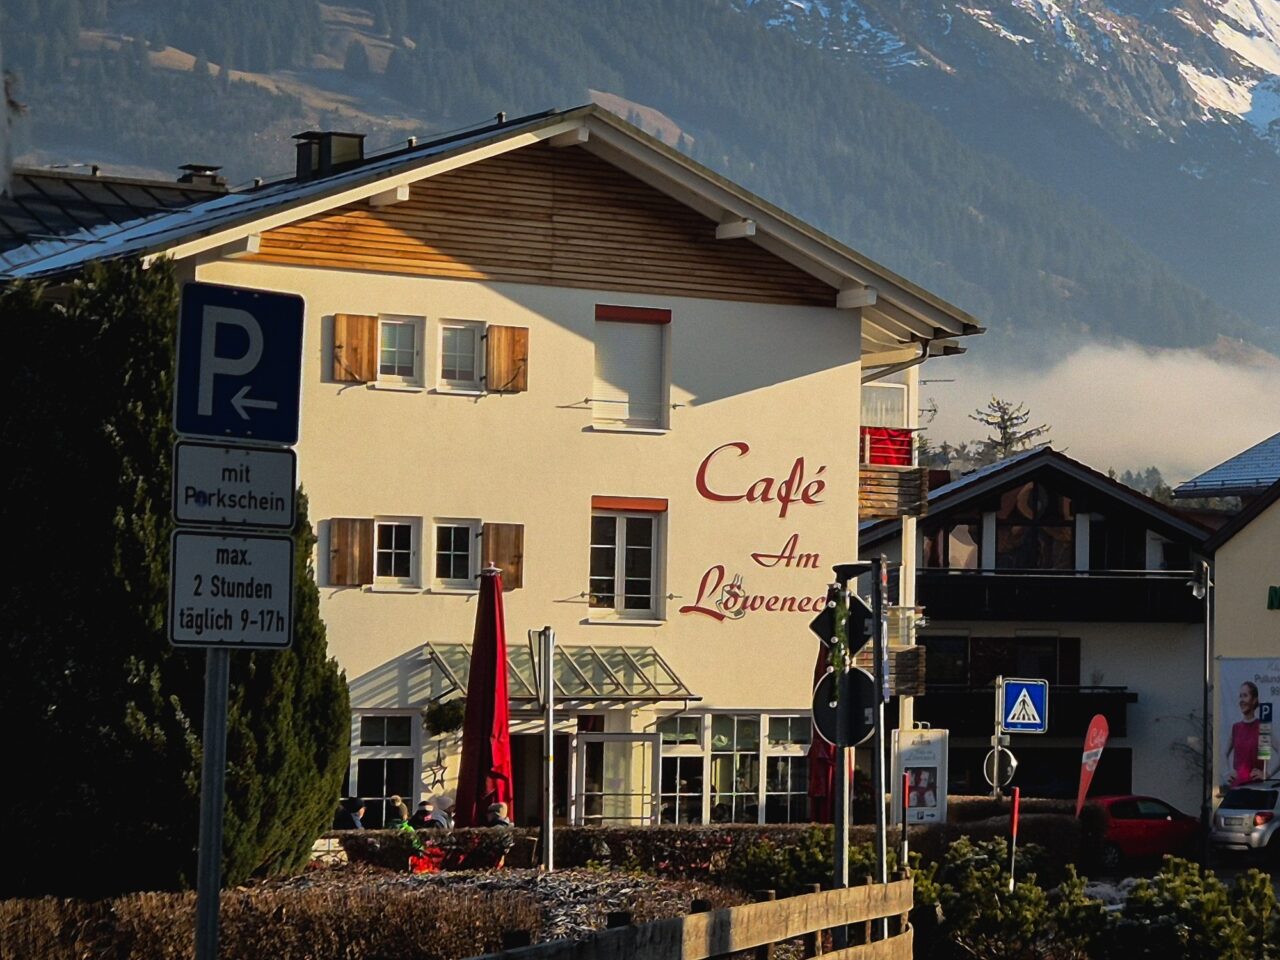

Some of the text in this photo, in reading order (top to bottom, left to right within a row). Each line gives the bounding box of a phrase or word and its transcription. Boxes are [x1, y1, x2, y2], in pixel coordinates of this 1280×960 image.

[197, 304, 264, 416] P
[222, 466, 251, 483] mit
[695, 441, 827, 519] Café
[184, 486, 285, 512] Prkschein
[216, 548, 252, 566] max.
[750, 533, 820, 569] Am
[193, 574, 272, 599] 2 Stunden
[678, 564, 827, 622] Löwenec
[179, 607, 285, 635] täglich 9-17h
[1262, 705, 1271, 720] P
